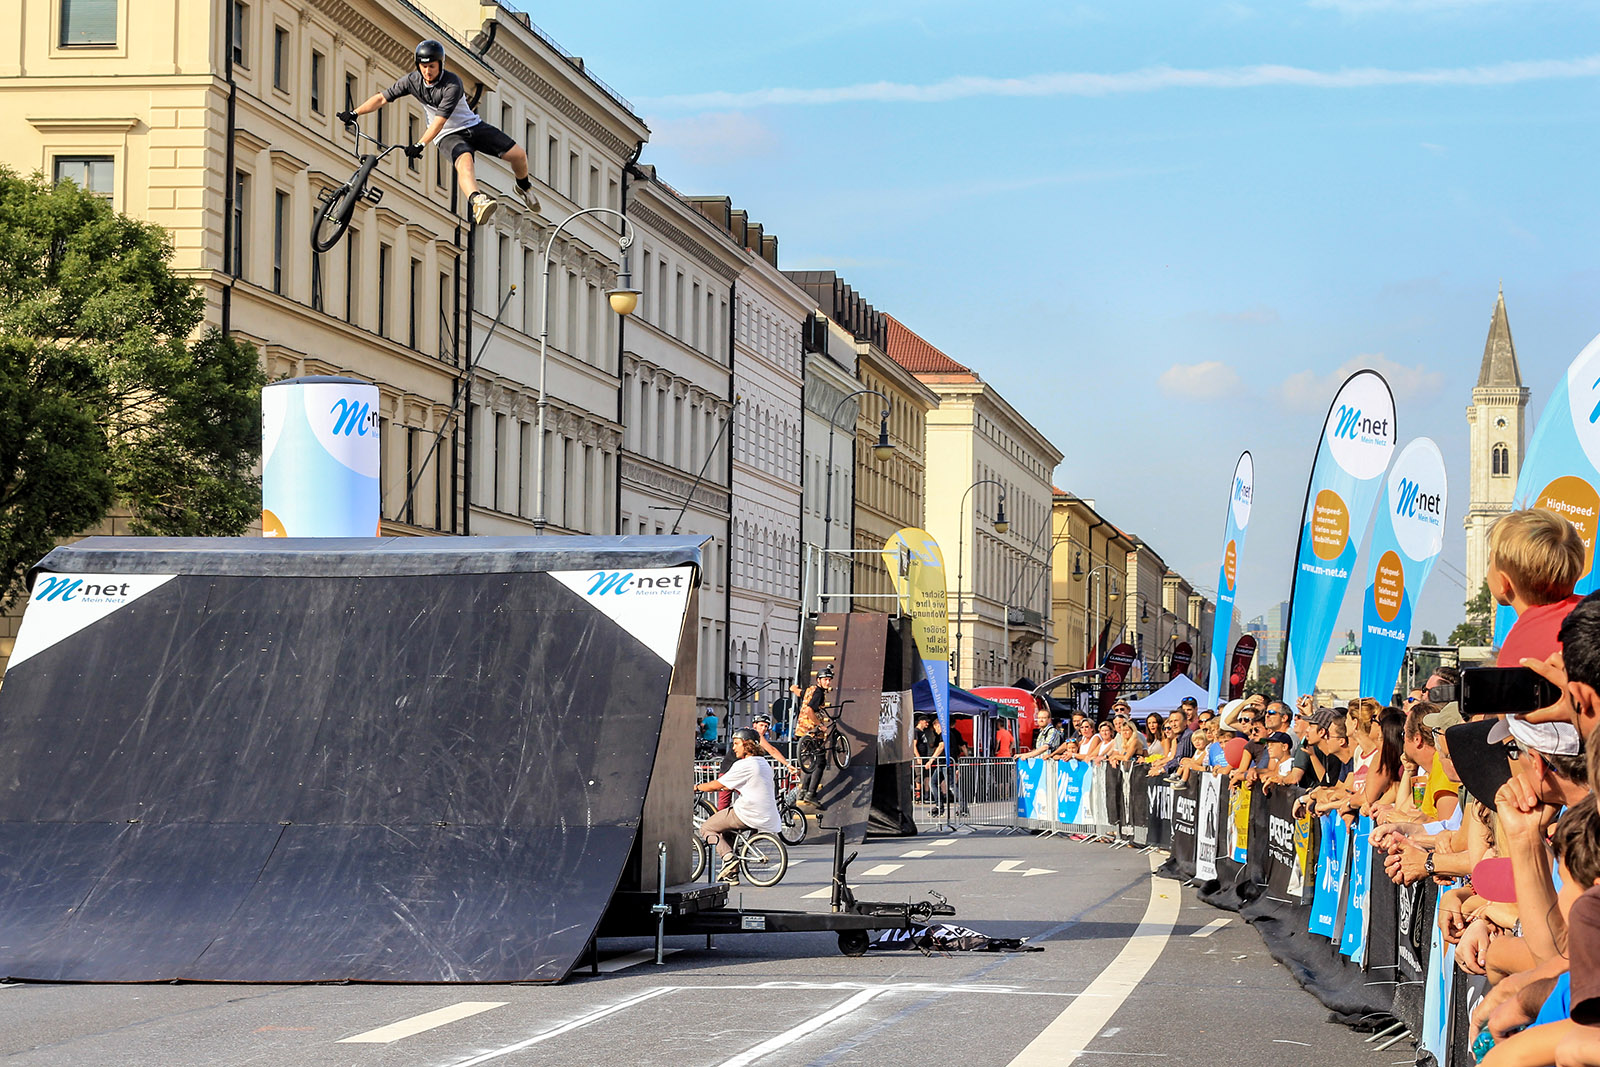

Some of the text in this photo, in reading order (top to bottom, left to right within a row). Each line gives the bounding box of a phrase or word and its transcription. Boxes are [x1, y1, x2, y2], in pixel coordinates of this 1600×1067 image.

[1360, 435, 1387, 447] Mein Netz
[1546, 498, 1596, 517] Highspeed-
[1417, 512, 1440, 526] Mein Netz
[1301, 562, 1348, 579] www.m-net.de
[1367, 624, 1406, 641] www.m-net.de
